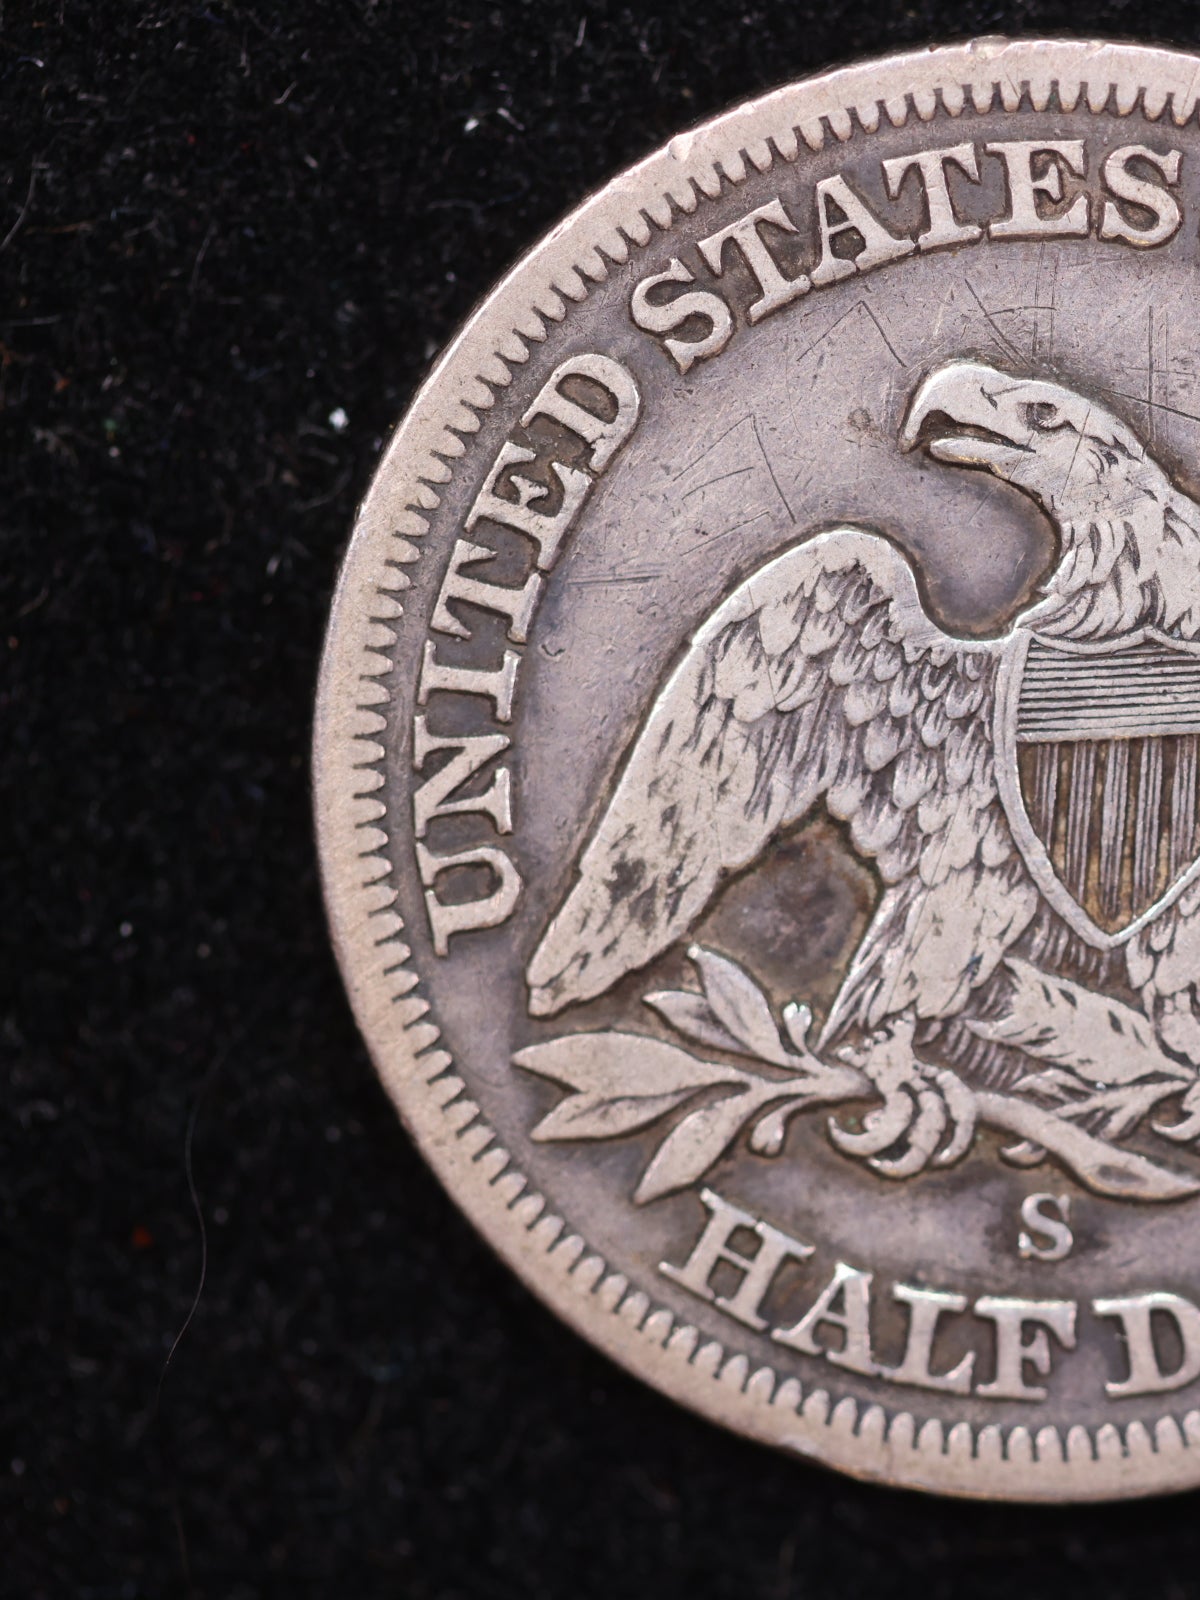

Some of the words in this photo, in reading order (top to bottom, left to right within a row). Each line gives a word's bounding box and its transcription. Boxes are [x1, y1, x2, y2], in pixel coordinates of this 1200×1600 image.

[417, 352, 641, 955] UNITED
[630, 140, 1183, 370] STATES
[659, 1189, 1077, 1400] HALF
[1017, 1192, 1073, 1259] S
